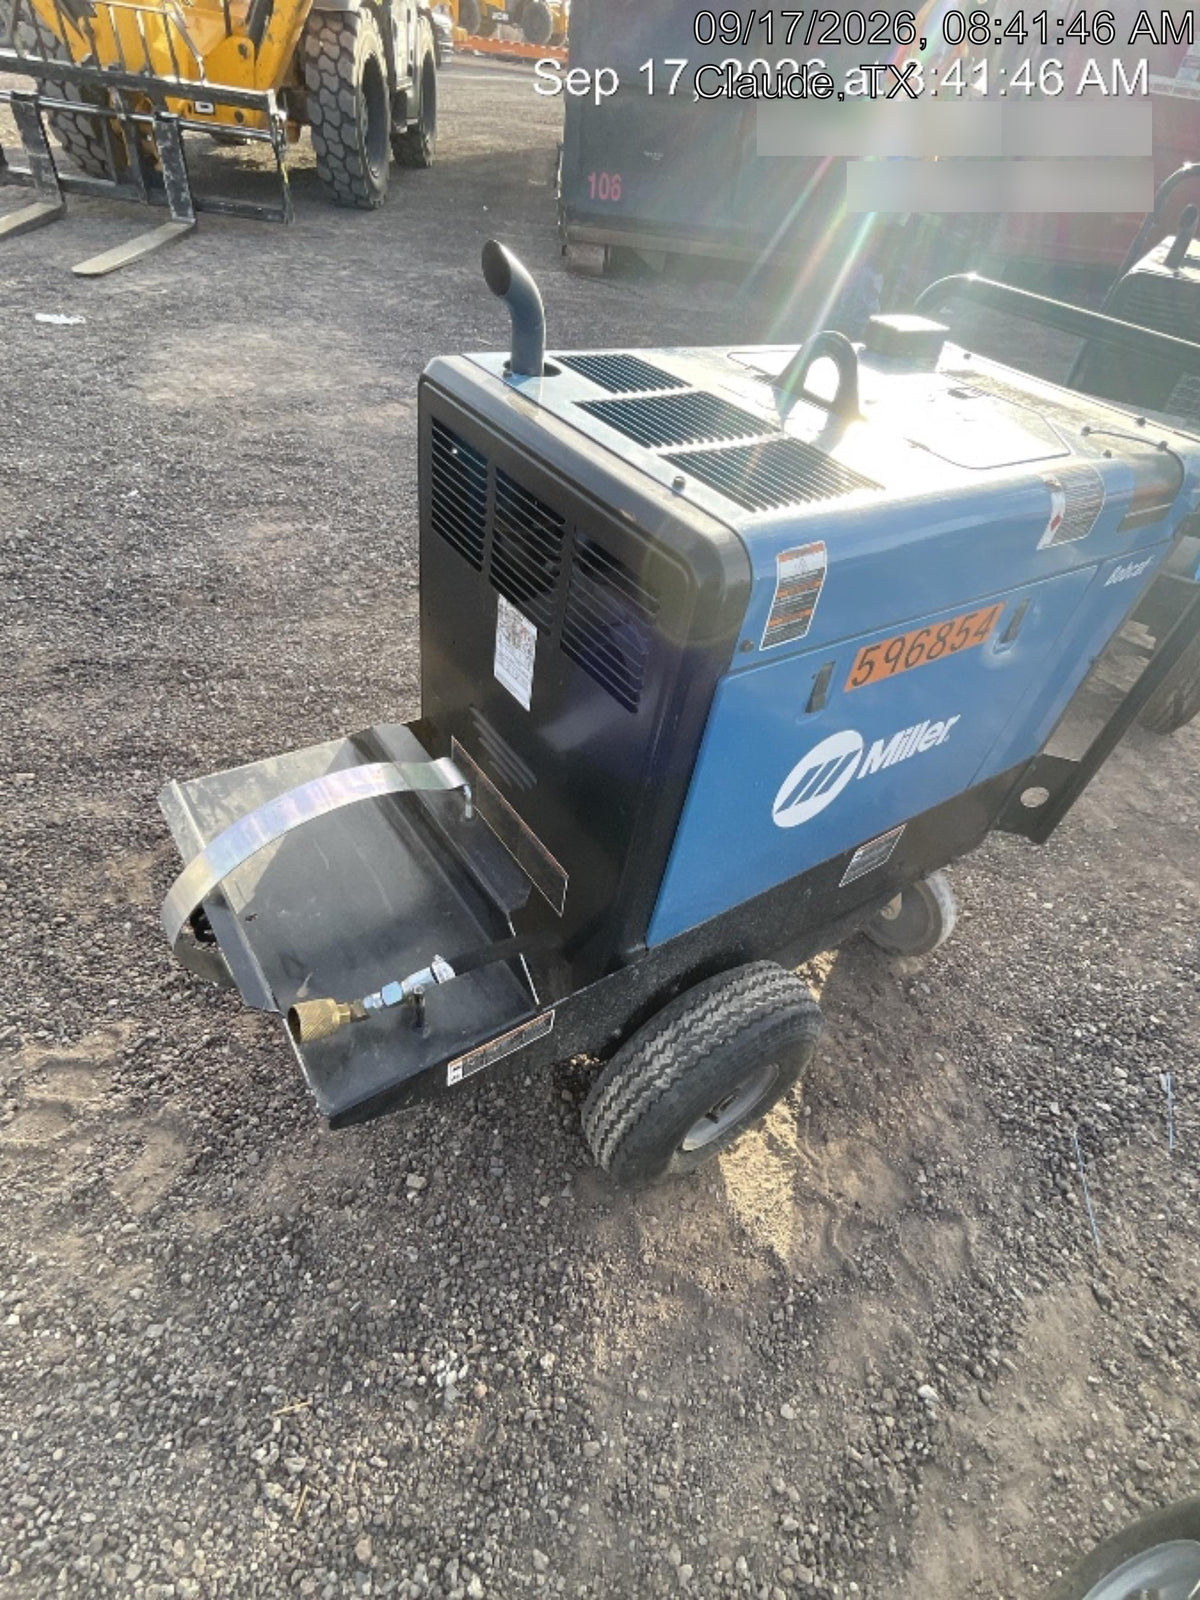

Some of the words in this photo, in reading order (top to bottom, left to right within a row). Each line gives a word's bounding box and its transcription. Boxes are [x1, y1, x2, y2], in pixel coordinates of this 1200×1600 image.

[588, 171, 622, 200] 106
[851, 605, 1000, 688] 596854
[856, 714, 961, 780] Miller
